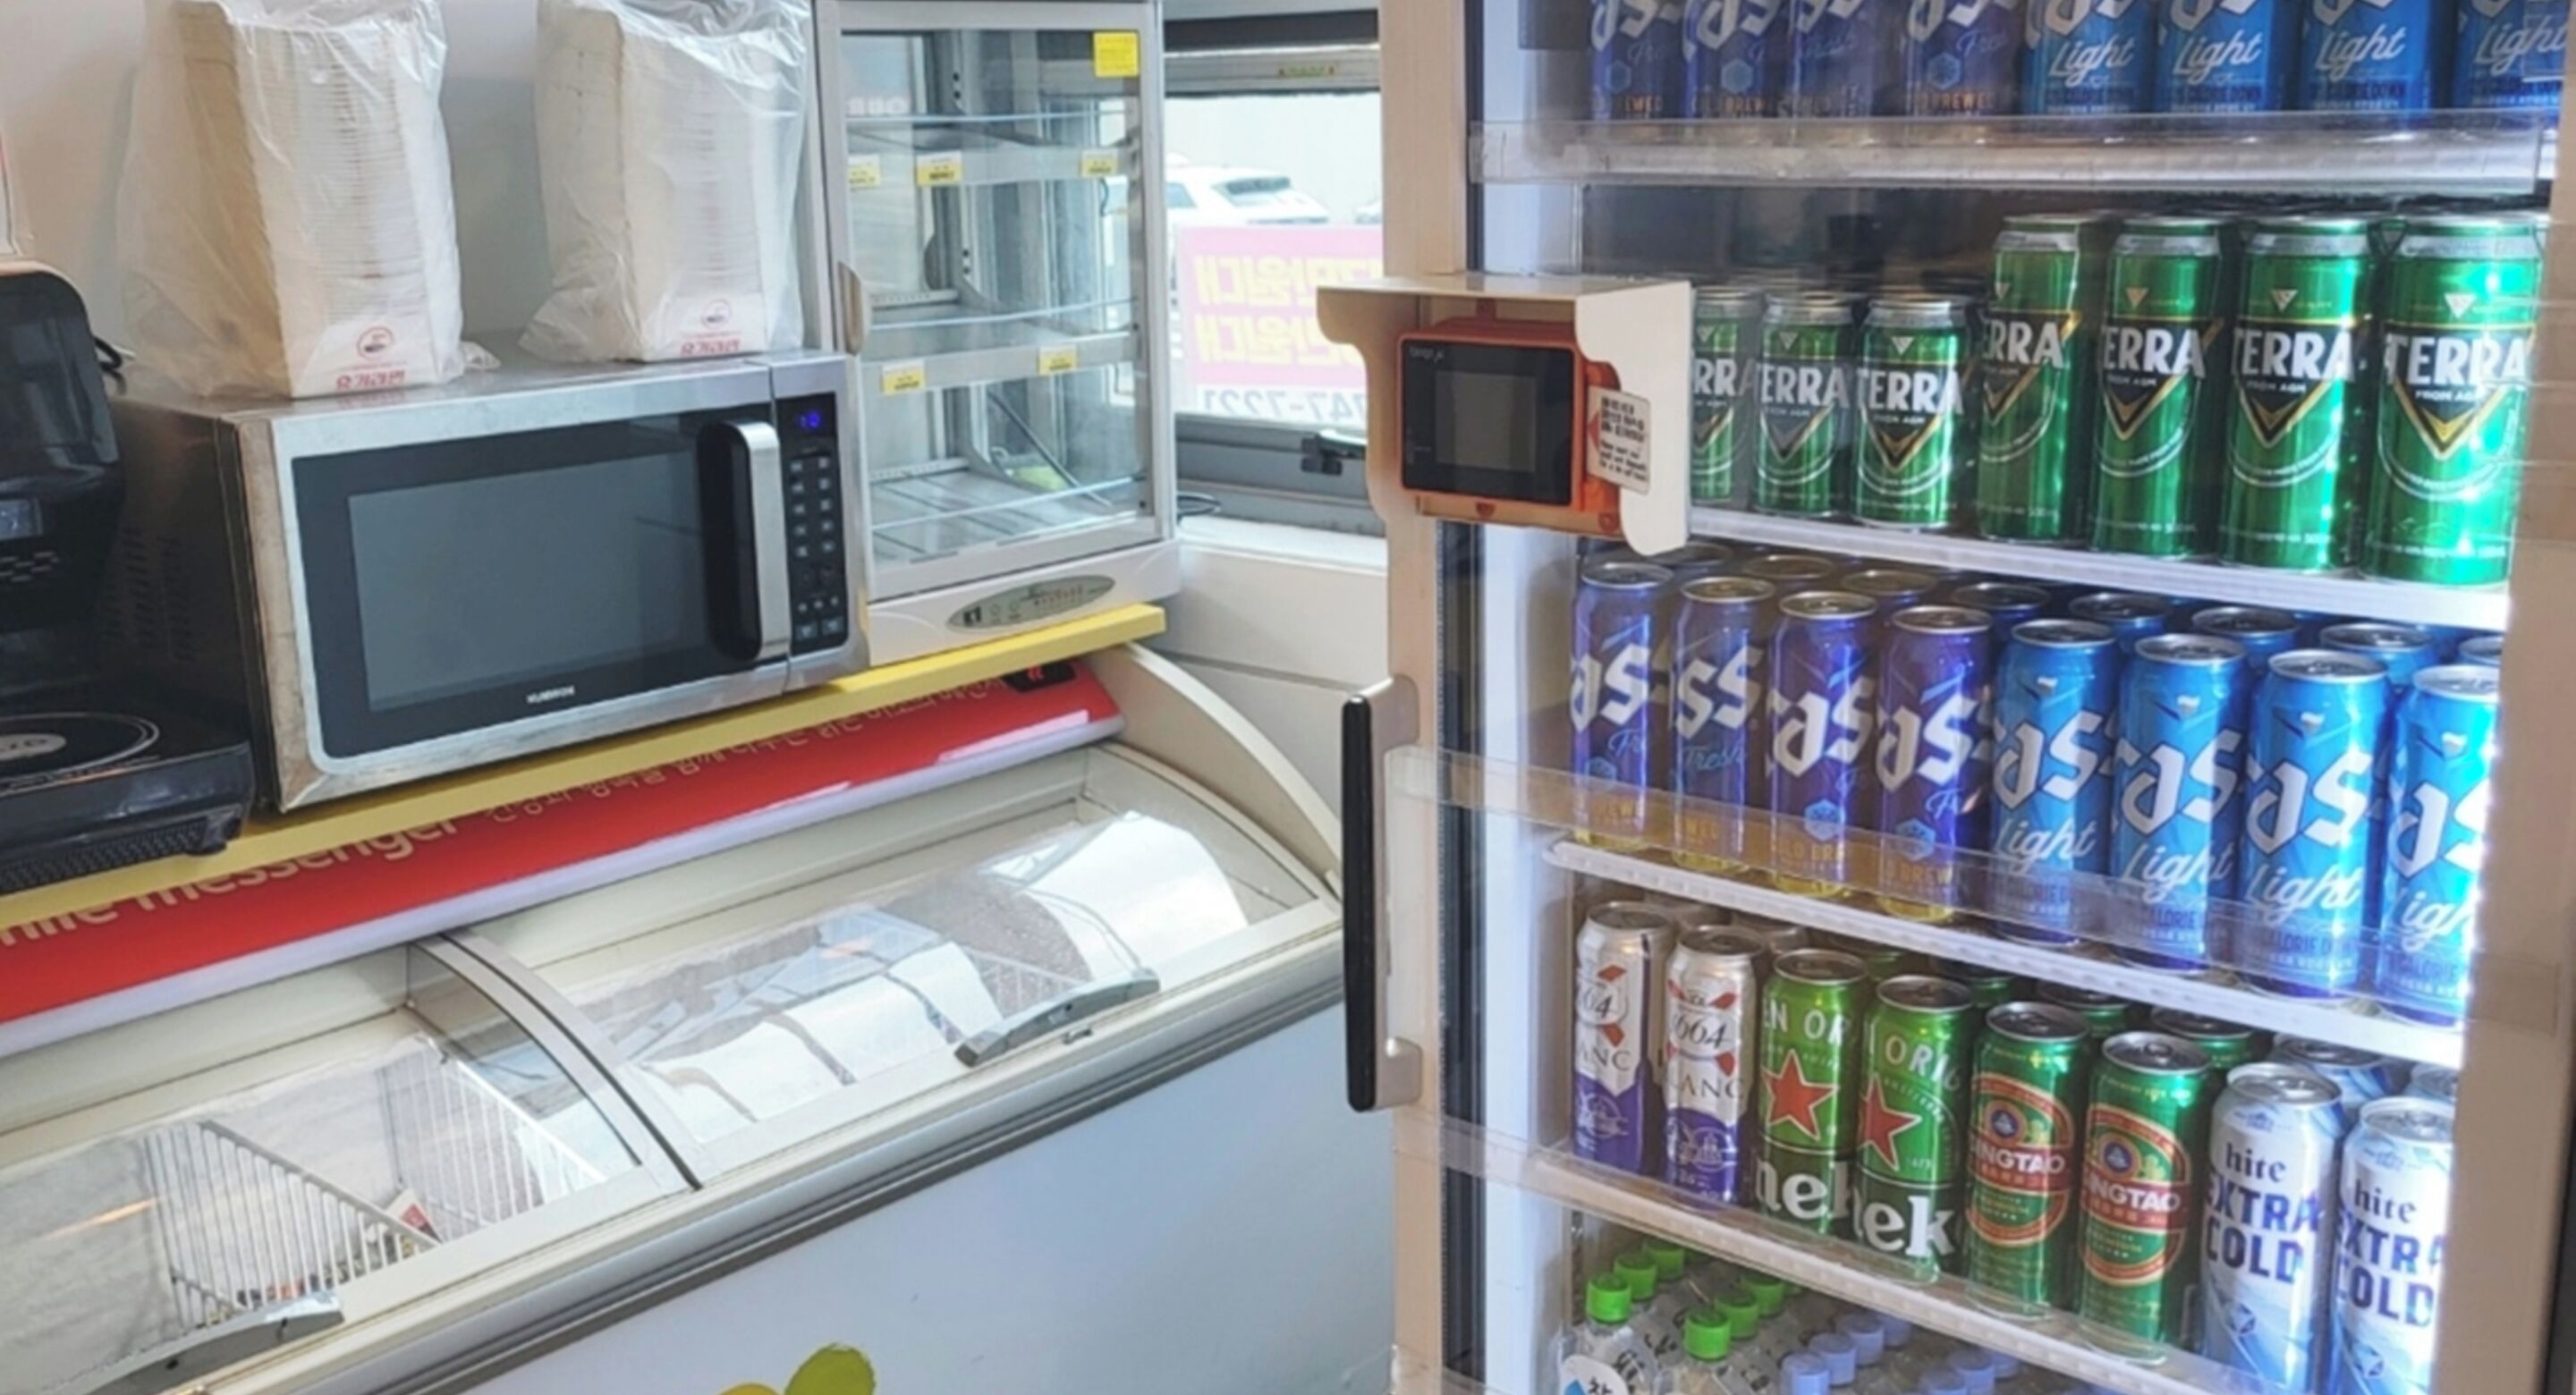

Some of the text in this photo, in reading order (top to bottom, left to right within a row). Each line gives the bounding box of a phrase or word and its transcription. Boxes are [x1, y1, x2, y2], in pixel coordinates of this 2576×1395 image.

[2048, 34, 2135, 87] Light
[2173, 30, 2263, 85] Light
[2315, 23, 2406, 82] Light
[2384, 332, 2527, 386] TERRA
[2225, 1141, 2287, 1183] hite
[2354, 1178, 2417, 1224] hite
[2205, 1213, 2305, 1286] COLD
